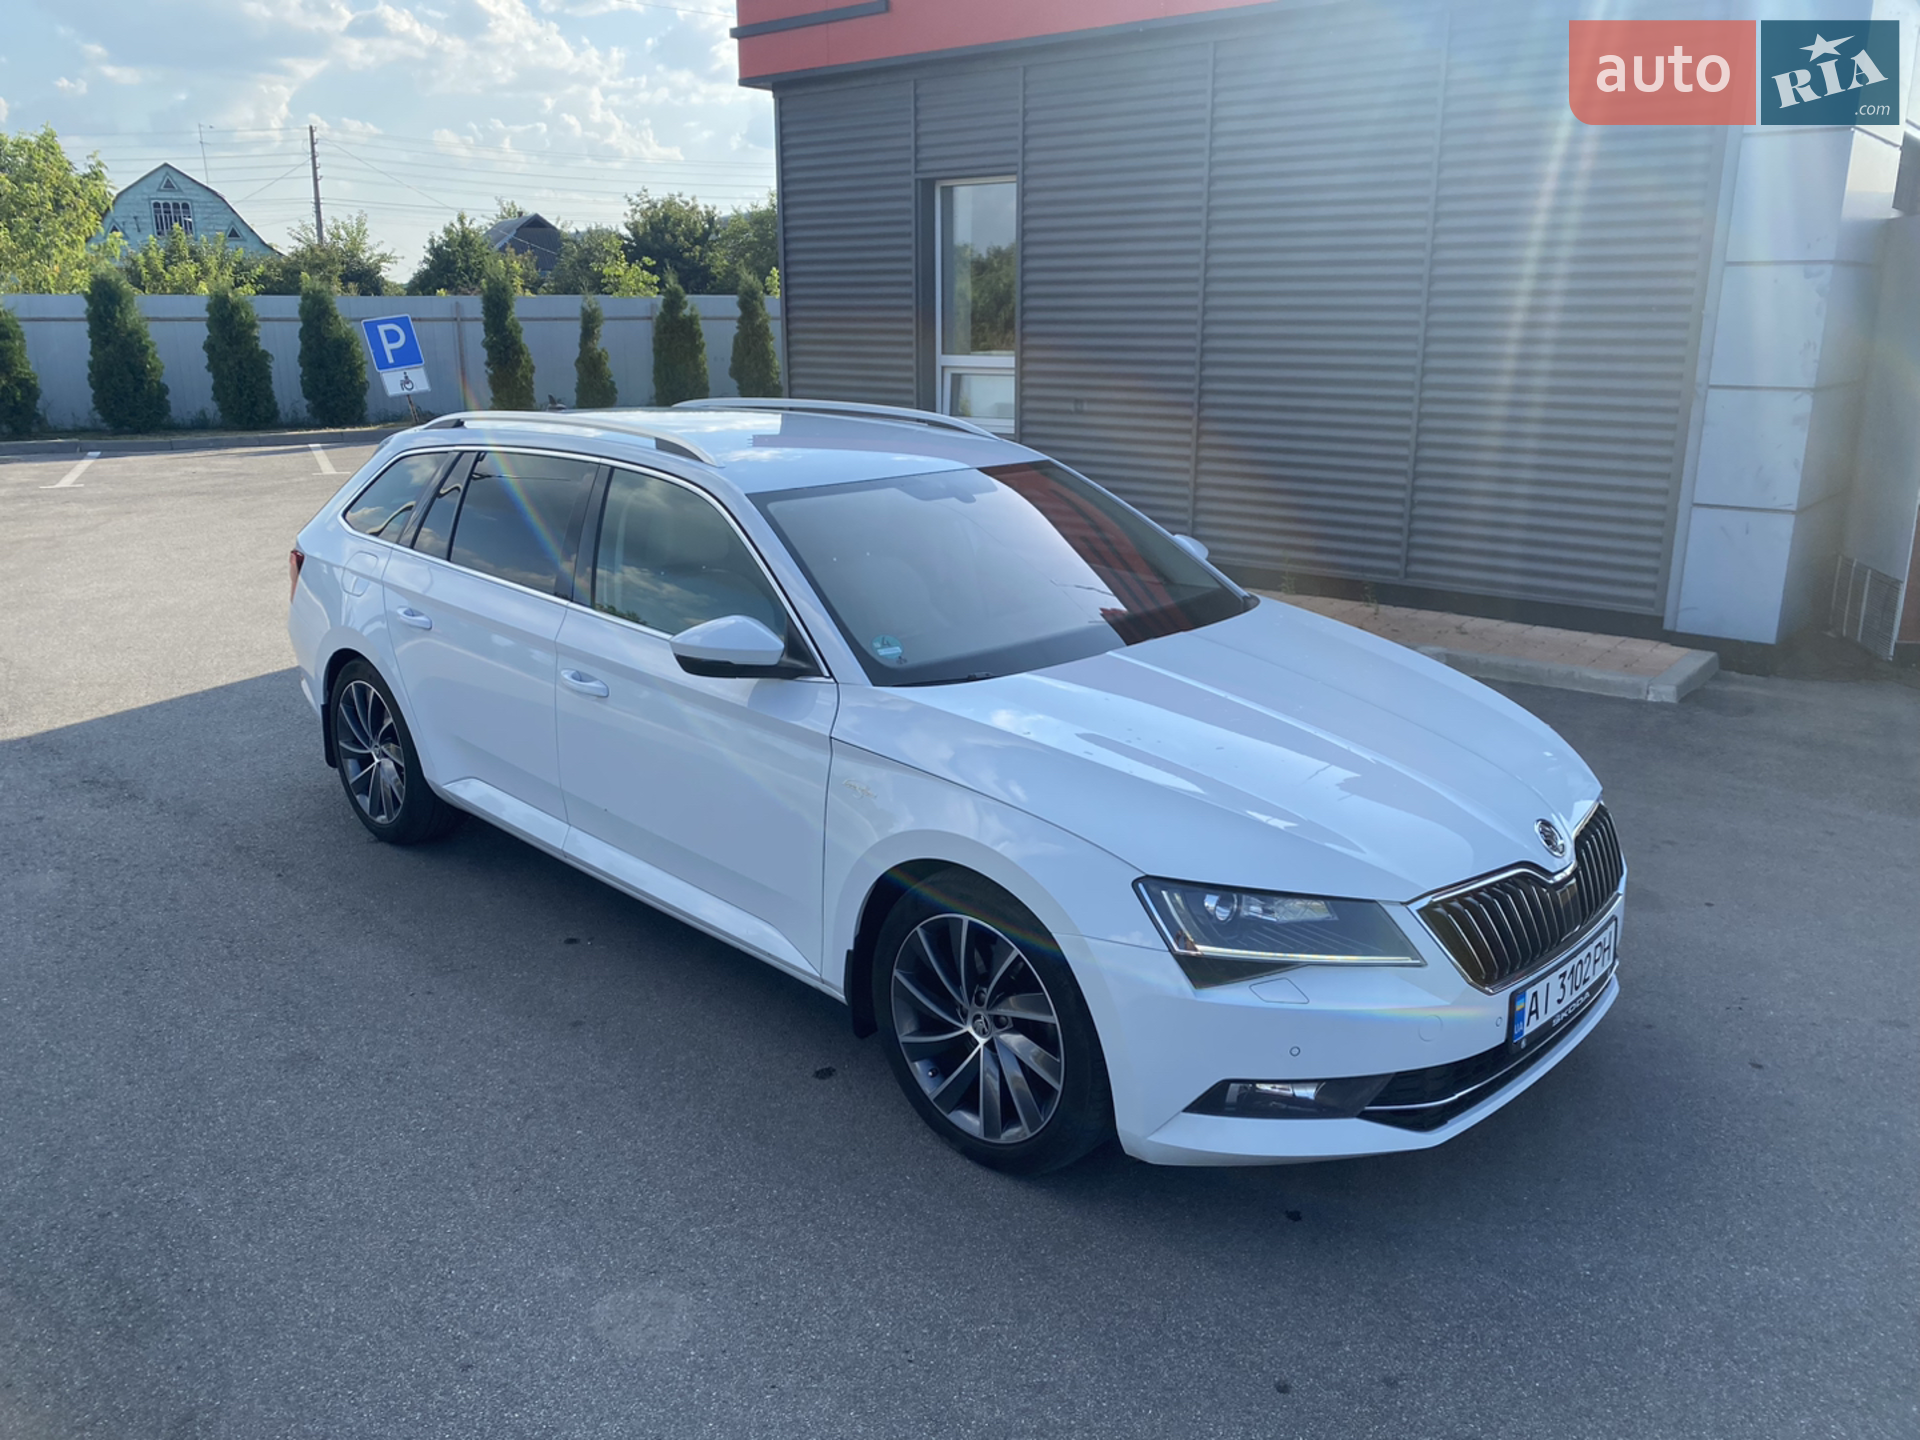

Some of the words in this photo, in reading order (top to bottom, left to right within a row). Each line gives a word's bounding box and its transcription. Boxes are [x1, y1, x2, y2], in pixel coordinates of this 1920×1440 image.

[376, 323, 406, 364] P
[1526, 982, 1550, 1027] AI
[1556, 951, 1591, 1005] 3102
